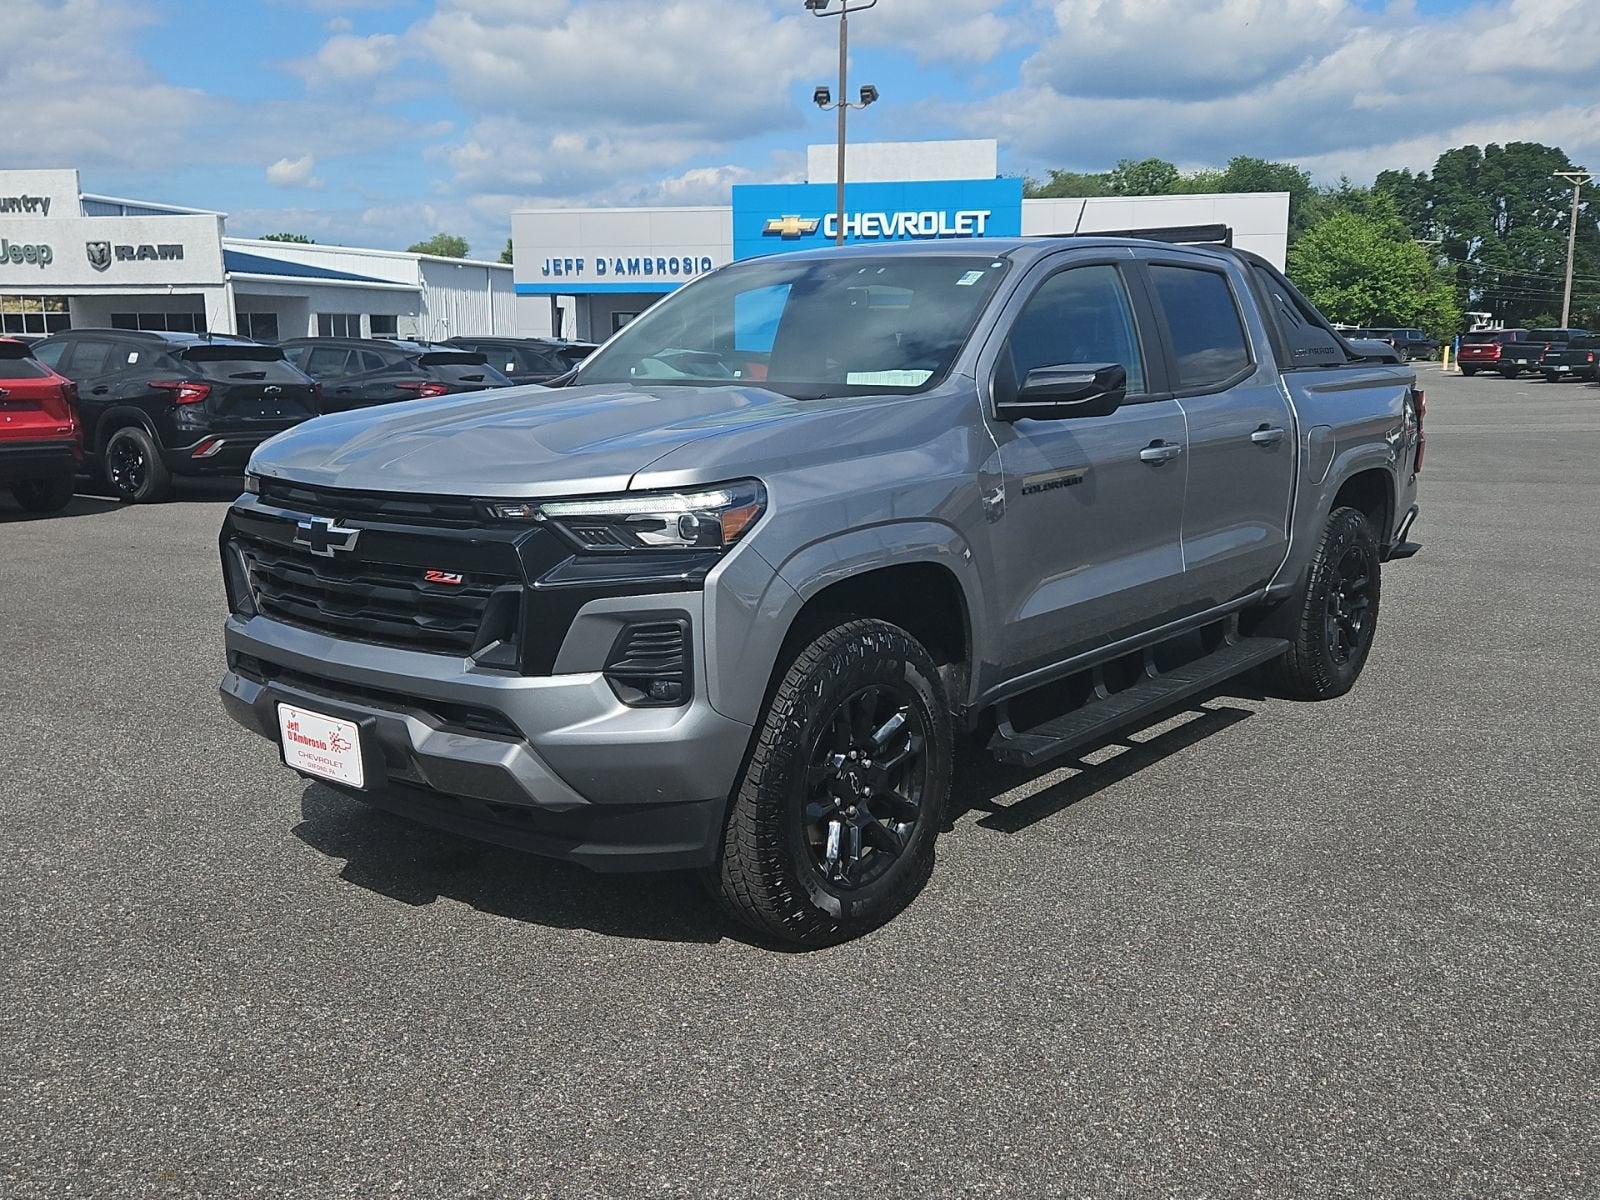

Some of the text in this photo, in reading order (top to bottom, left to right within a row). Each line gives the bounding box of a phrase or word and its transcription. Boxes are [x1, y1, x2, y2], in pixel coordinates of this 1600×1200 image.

[823, 210, 991, 238] CHEVROLET
[0, 239, 53, 269] Jeep
[114, 244, 184, 261] RAM
[542, 256, 712, 276] JEFF D'AMBROSIO
[424, 570, 463, 584] Z71
[287, 720, 300, 732] Jeff
[287, 730, 327, 750] D'Ambrosio
[298, 750, 344, 769] CHEVROLET
